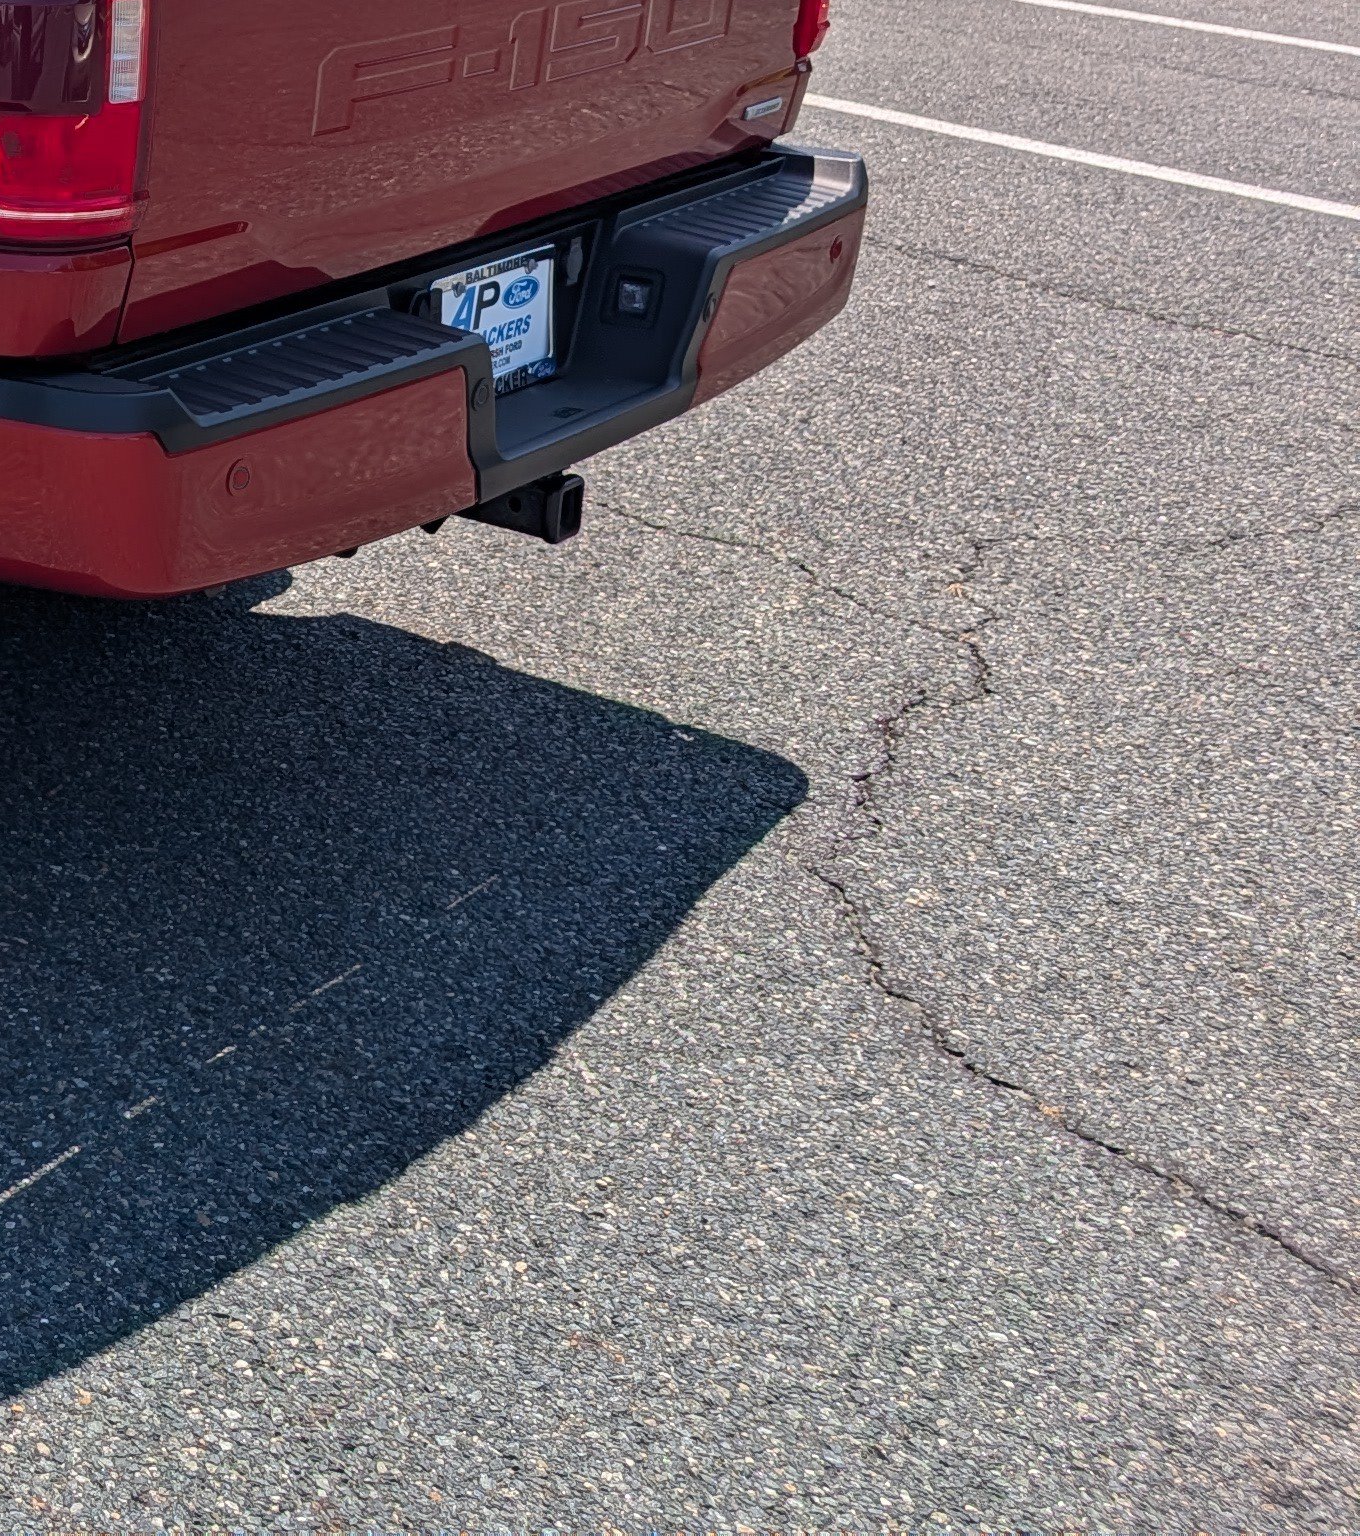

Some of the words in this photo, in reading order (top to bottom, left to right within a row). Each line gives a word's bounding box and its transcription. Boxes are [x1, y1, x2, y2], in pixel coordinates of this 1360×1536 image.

[465, 257, 529, 284] BALTIMORE
[509, 281, 533, 304] Ford
[505, 340, 523, 354] FORD
[495, 364, 529, 395] CKER
